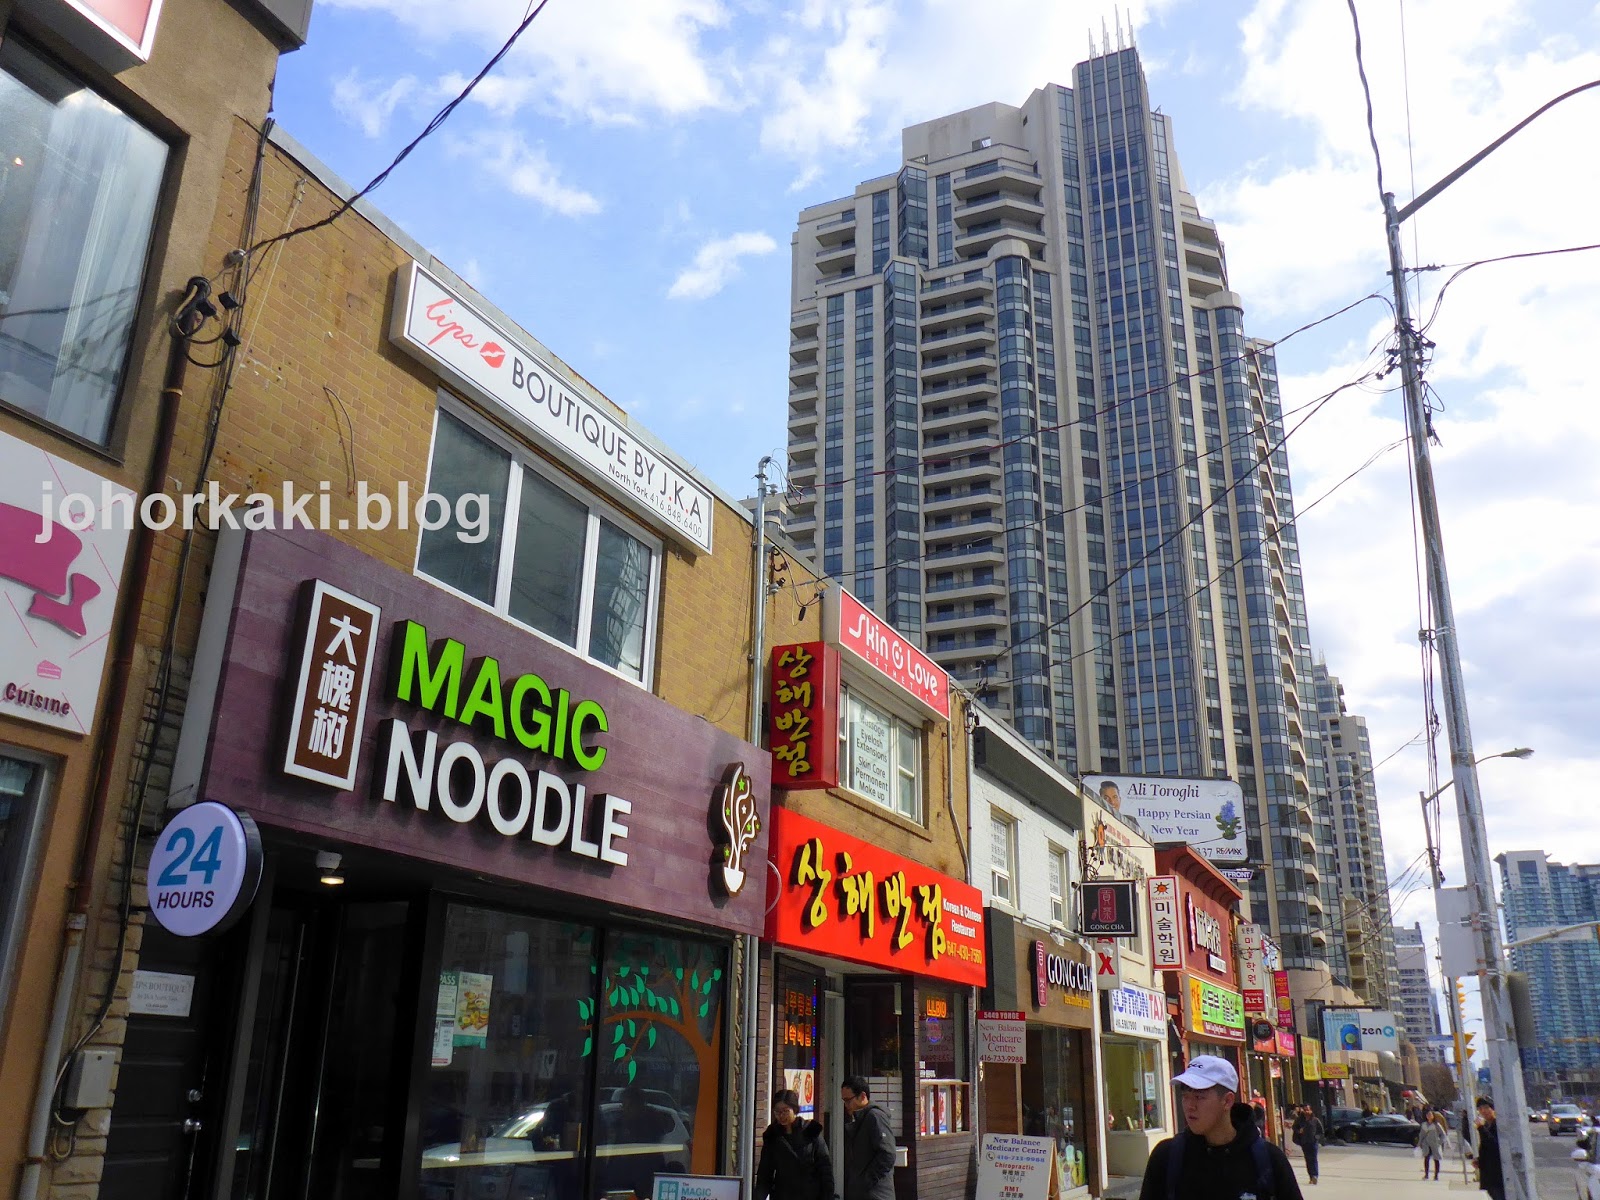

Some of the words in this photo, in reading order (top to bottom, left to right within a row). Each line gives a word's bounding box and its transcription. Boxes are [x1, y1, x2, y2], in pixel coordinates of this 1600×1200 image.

[426, 298, 479, 348] lips
[512, 356, 627, 467] BOUTIQUE
[634, 449, 656, 485] BY
[608, 462, 632, 488] North
[632, 481, 648, 500] York
[649, 492, 703, 538] 416.848.6400
[849, 614, 889, 660] Skin
[907, 650, 938, 697] Love
[866, 651, 929, 702] ESTHETIC
[308, 614, 362, 761] 大槐树
[396, 619, 610, 771] MAGIC
[5, 683, 71, 717] Cuisine
[774, 646, 814, 777] 상해반점
[861, 729, 883, 749] Eyelash
[857, 738, 887, 763] Extensions
[858, 756, 871, 769] Skin
[873, 764, 886, 778] Care
[855, 767, 888, 792] Permanent
[859, 781, 876, 797] Make
[383, 718, 631, 867] NOODLE
[1127, 783, 1146, 797] Ali
[1150, 784, 1200, 802] Toroghi
[1138, 808, 1170, 820] Happy
[1174, 808, 1211, 820] Persian
[1151, 824, 1173, 835] New
[1175, 826, 1199, 836] Year
[157, 826, 224, 887] 24
[157, 890, 214, 909] HOURS
[798, 838, 946, 961] 상해반점
[943, 898, 959, 915] Korean
[964, 906, 982, 923] Chinese
[951, 919, 976, 938] Restaurant
[1090, 923, 1110, 931] GONG
[1155, 901, 1176, 963] 미술학원
[1047, 953, 1076, 989] GONG
[1000, 1012, 1019, 1020] YONGE
[1149, 994, 1165, 1022] TAX
[980, 1023, 994, 1031] New
[998, 1024, 1024, 1032] Balance
[982, 1033, 1022, 1043] Medicare
[1362, 1025, 1394, 1037] zenQ
[988, 1043, 1016, 1052] Centre
[980, 1054, 1024, 1063] 416-733-9988
[986, 1144, 1019, 1152] Medicare
[1022, 1146, 1047, 1154] Centre
[1011, 1138, 1041, 1146] Balance
[994, 1162, 1035, 1171] Chiropractic
[681, 1188, 711, 1197] MAGIC
